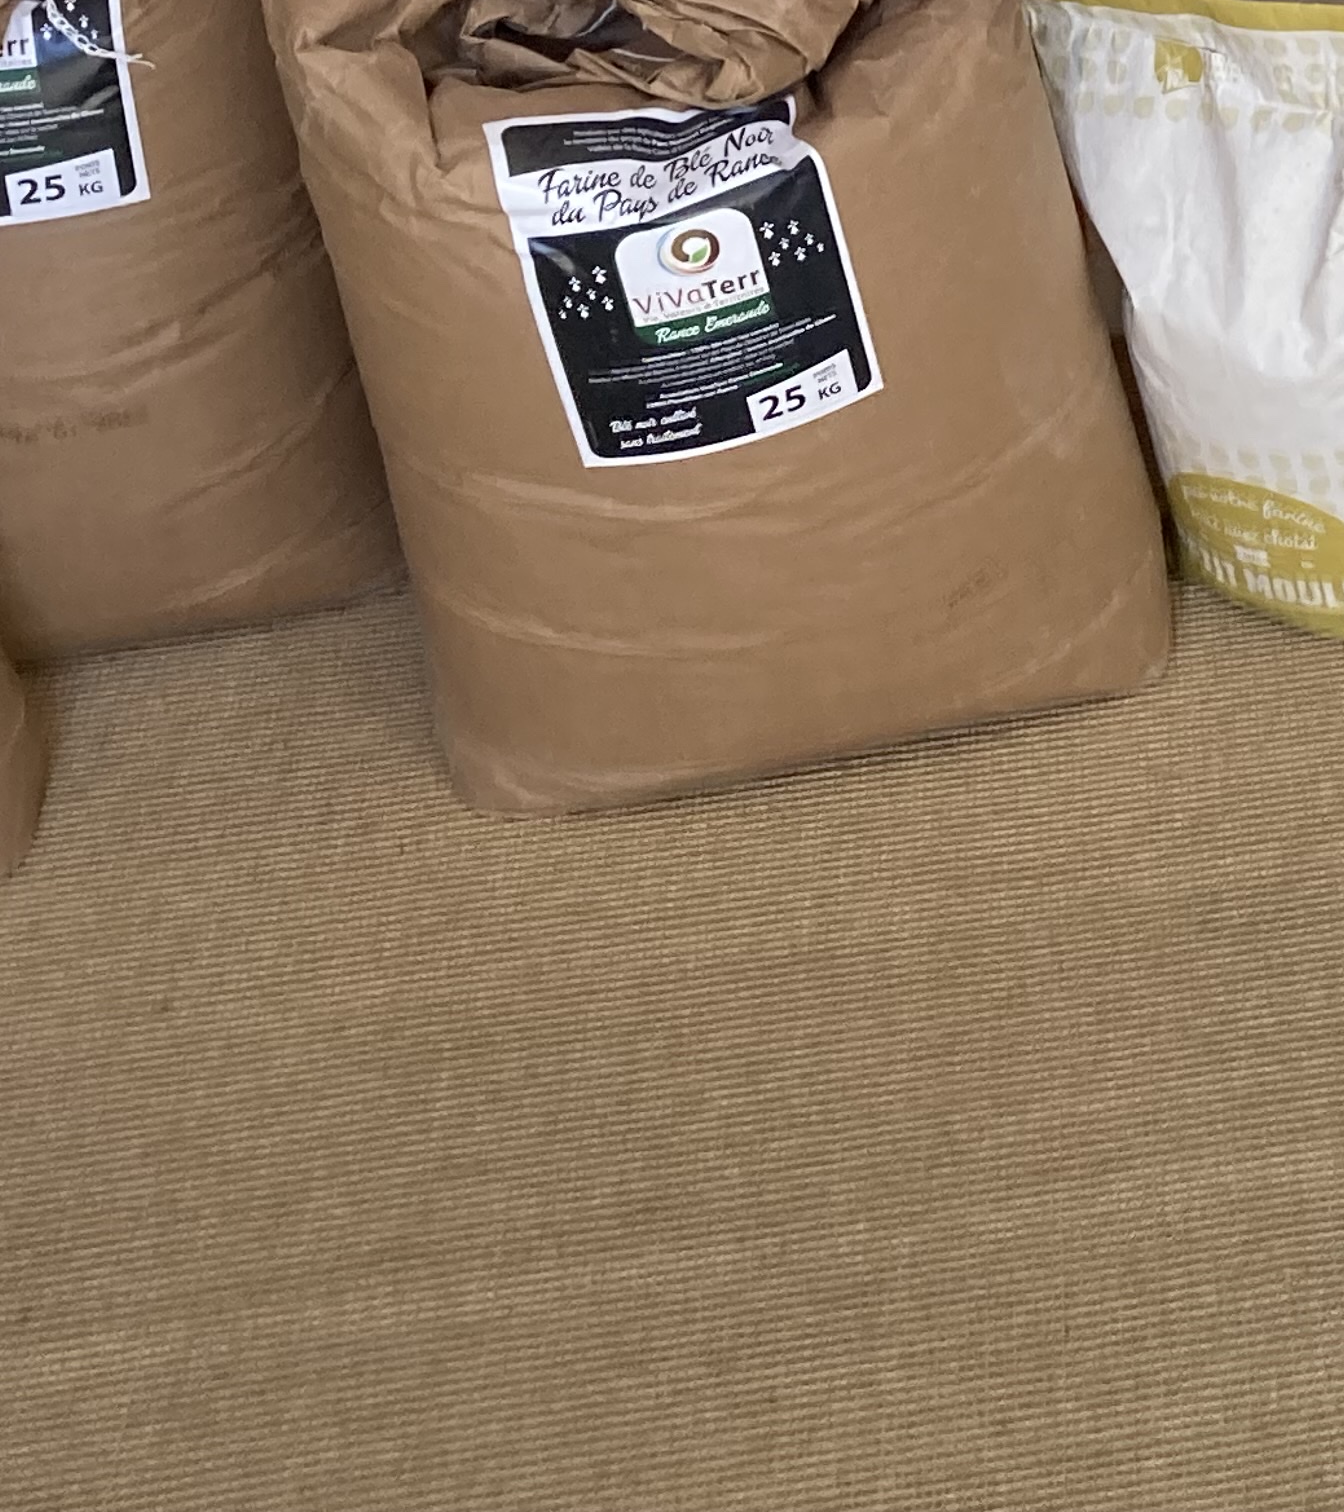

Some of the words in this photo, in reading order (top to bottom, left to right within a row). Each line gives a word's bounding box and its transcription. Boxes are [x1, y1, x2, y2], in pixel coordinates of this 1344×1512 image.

[537, 169, 622, 204] Farine
[629, 165, 658, 190] de
[663, 147, 714, 183] Blé
[723, 125, 776, 158] Noir
[17, 174, 66, 206] 25
[79, 180, 104, 197] KG
[551, 200, 587, 227] du
[592, 189, 658, 224] Pays
[667, 178, 698, 204] de
[632, 269, 760, 315] ViVaTerr
[655, 325, 701, 346] Rance
[758, 384, 807, 421] 25
[817, 380, 842, 401] KG
